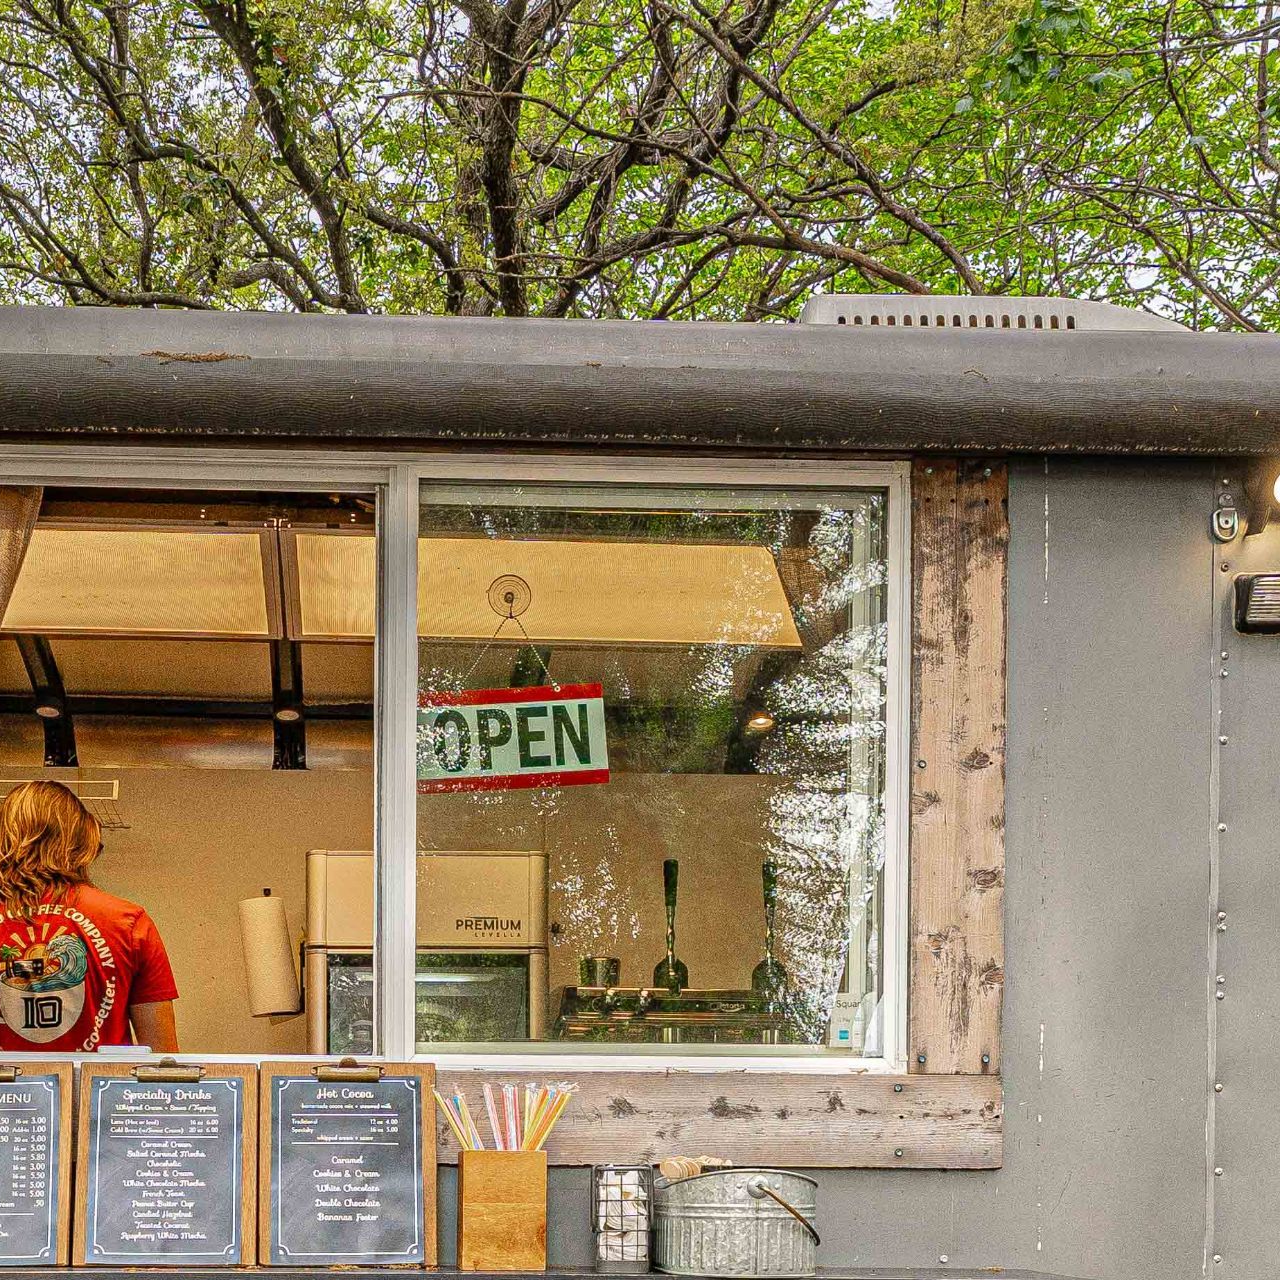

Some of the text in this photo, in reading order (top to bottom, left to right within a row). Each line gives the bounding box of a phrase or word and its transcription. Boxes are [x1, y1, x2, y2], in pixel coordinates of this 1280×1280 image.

[433, 704, 592, 773] OPEN
[456, 917, 522, 931] PREMIUM
[64, 907, 115, 969] COMPANY
[22, 996, 63, 1029] 10
[122, 1088, 212, 1104] Specialty Drinks
[316, 1087, 374, 1099] Hot Cocoa
[32, 1125, 46, 1133] 1.00
[30, 1144, 46, 1152] 5.00
[331, 1155, 364, 1164] Caramel
[30, 1163, 46, 1171] 3.00
[313, 1169, 381, 1178] Cookies & Cream
[316, 1183, 380, 1192] White Chocolate
[29, 1190, 45, 1198] 5.00
[314, 1198, 381, 1207] Double Chocolate
[317, 1212, 353, 1221] Bananas
